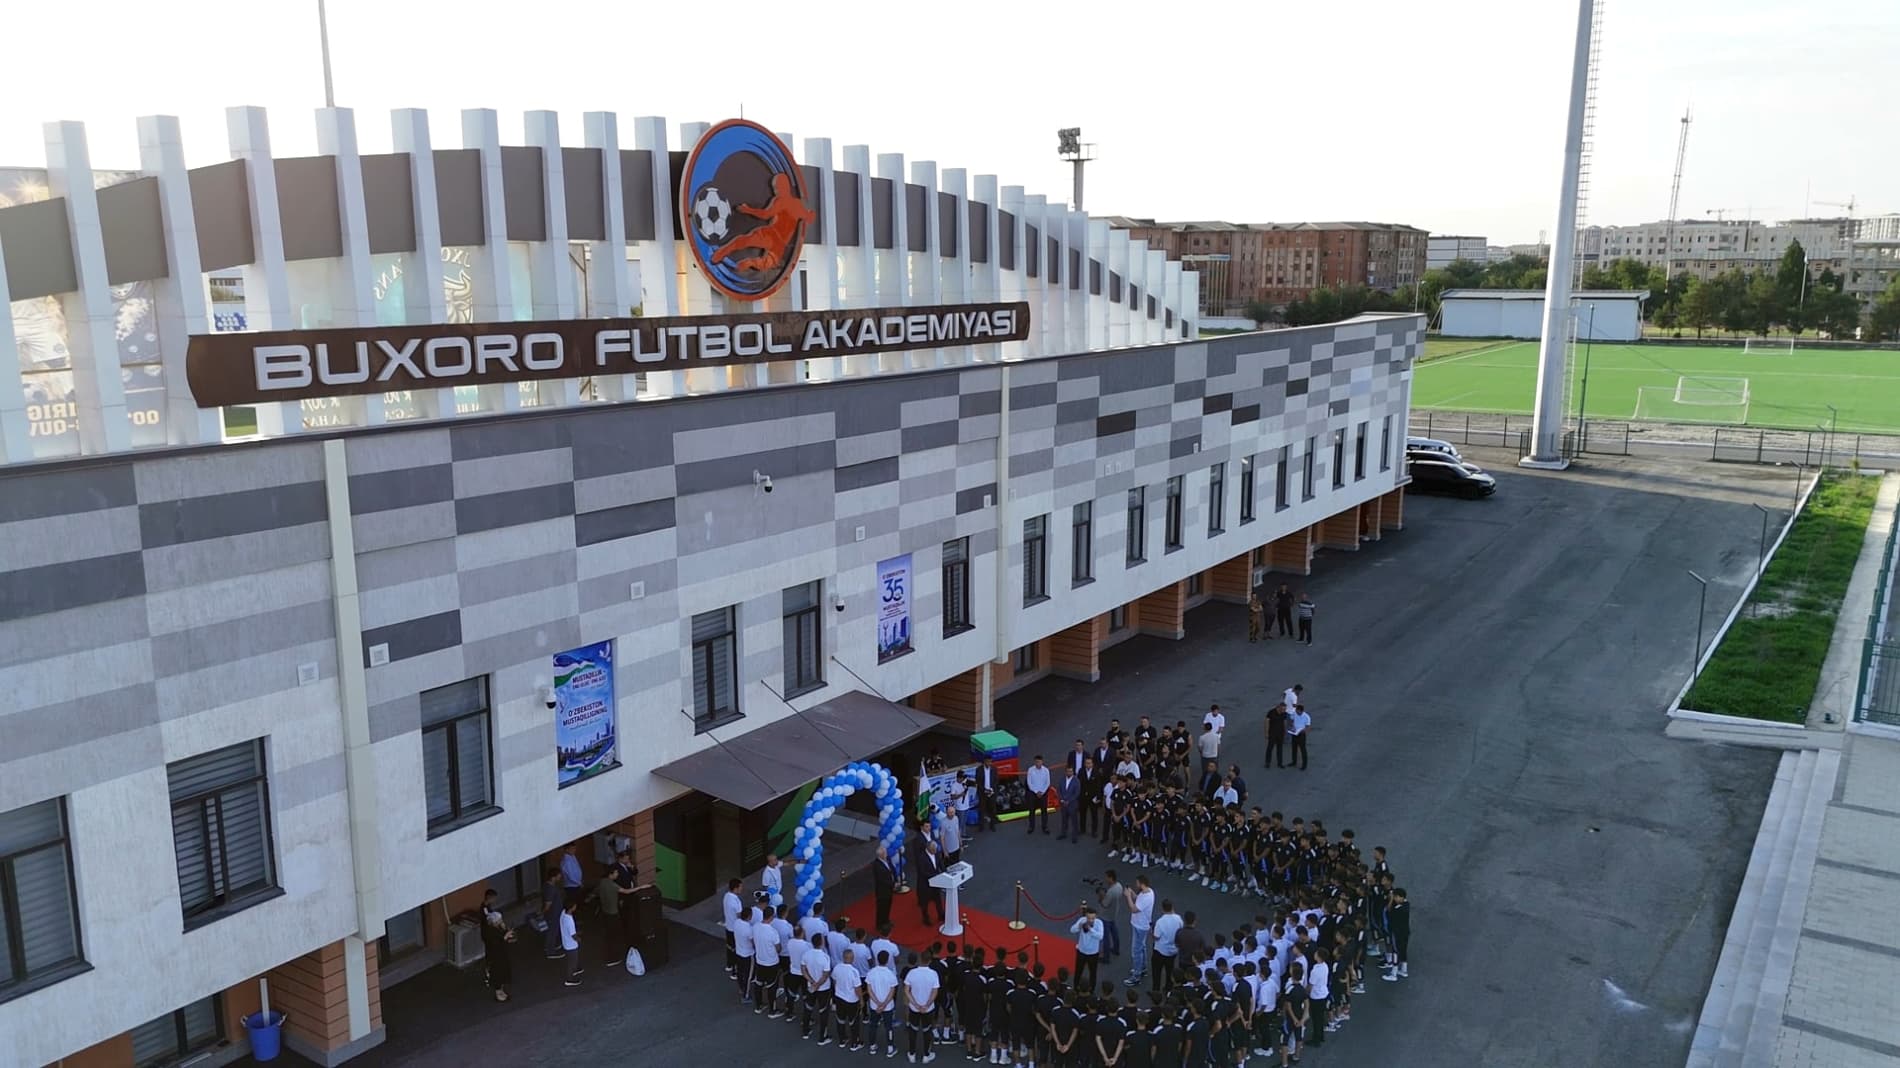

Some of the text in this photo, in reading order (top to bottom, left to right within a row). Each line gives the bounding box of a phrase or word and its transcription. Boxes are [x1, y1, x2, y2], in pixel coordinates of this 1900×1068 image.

[253, 309, 1017, 391] BUXORO FUTBOL AKADEMIYASI
[882, 578, 904, 603] 35
